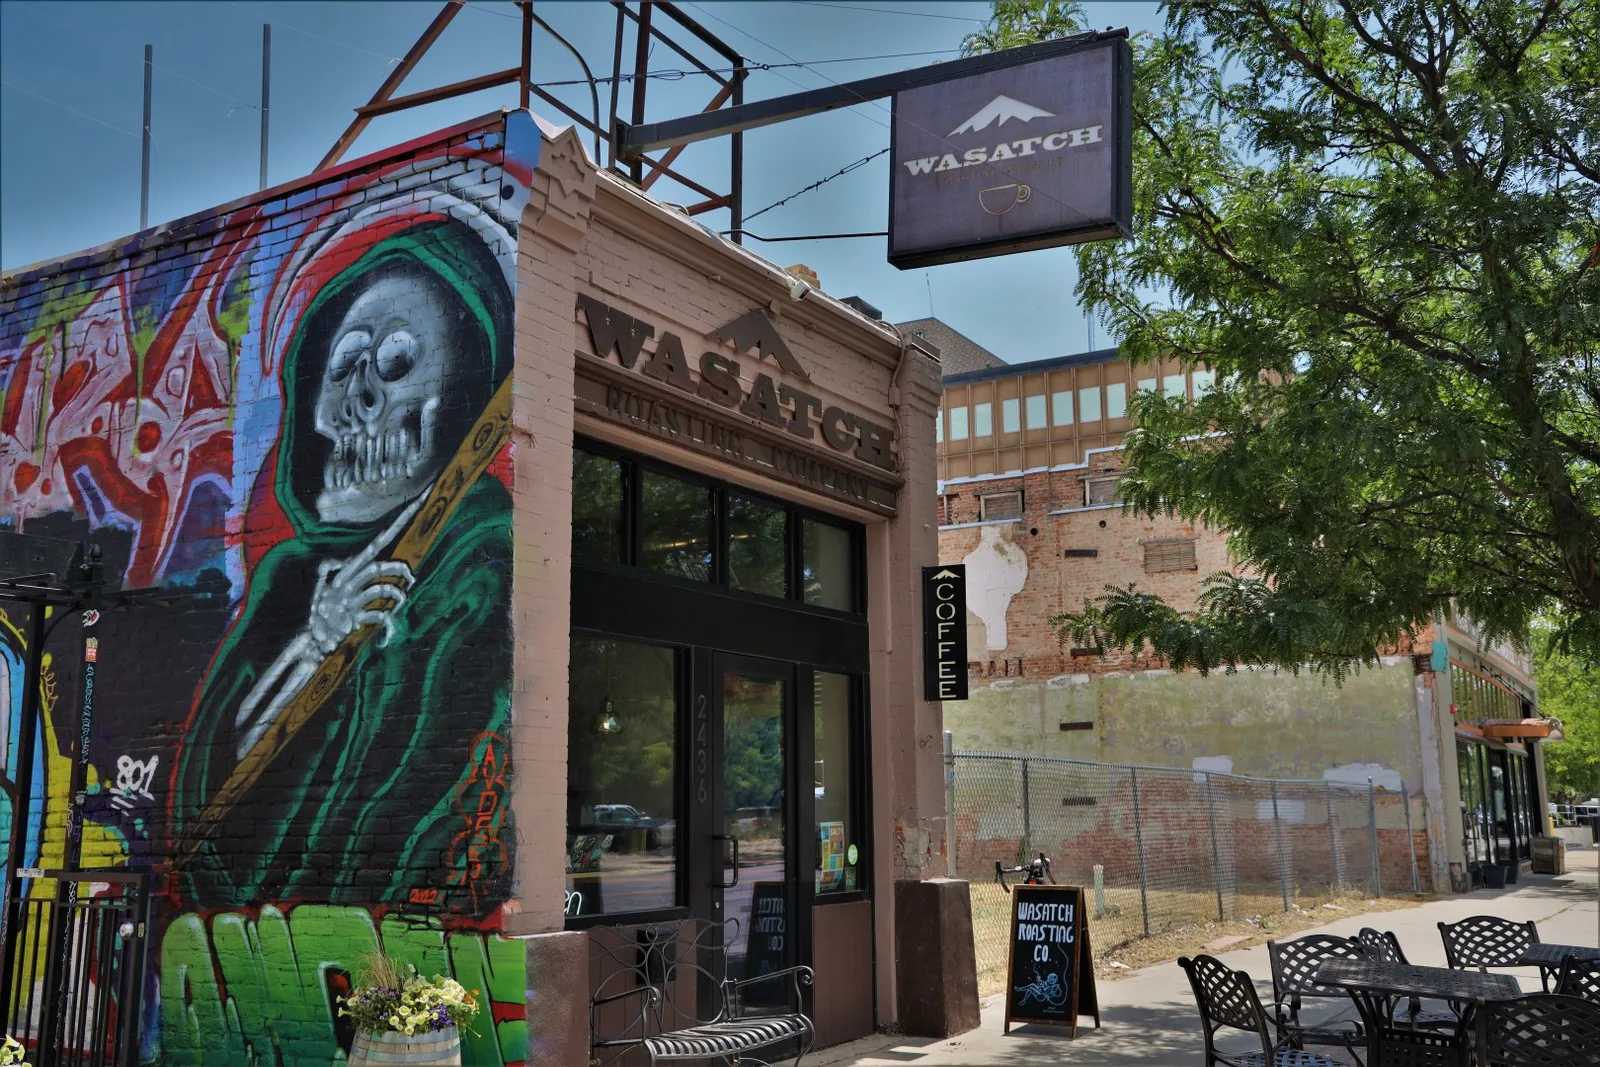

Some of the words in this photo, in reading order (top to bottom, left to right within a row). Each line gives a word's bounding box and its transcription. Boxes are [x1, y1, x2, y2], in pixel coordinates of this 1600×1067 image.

[904, 125, 1103, 176] WASATCH
[576, 292, 897, 474] WASATCH
[936, 583, 956, 698] COFFEE
[697, 694, 707, 803] 2436
[1018, 902, 1074, 922] WASATCH
[1018, 923, 1074, 943] ROASTING
[1033, 944, 1052, 962] CO.
